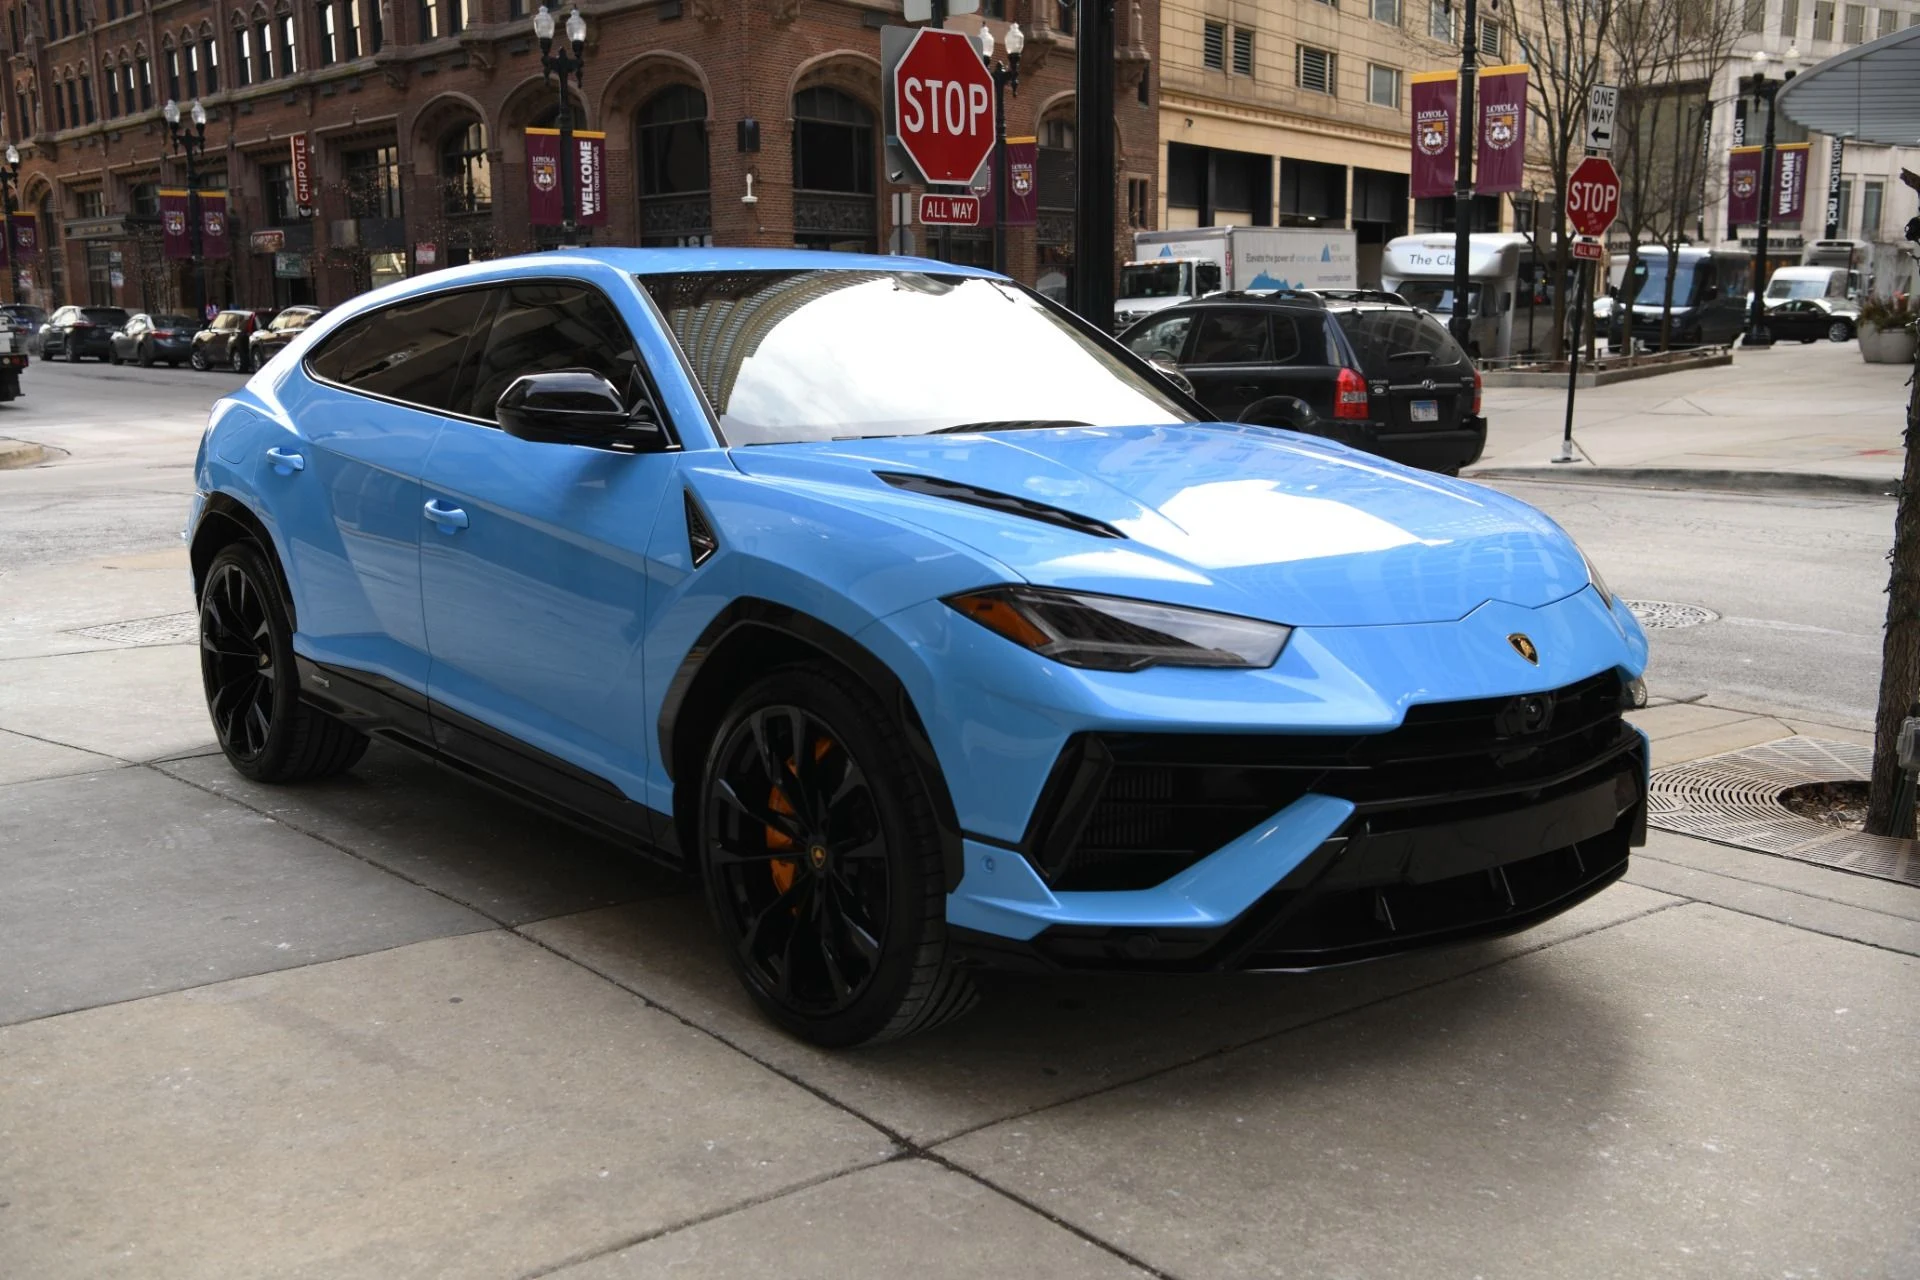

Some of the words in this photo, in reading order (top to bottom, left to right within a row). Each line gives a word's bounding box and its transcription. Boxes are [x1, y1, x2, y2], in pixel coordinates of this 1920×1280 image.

[904, 77, 988, 136] STOP
[1593, 90, 1614, 107] ONE
[1417, 110, 1448, 119] LOYOLA
[1486, 103, 1518, 113] LOYOLA
[1591, 109, 1613, 124] WAY
[295, 138, 309, 201] CHIPOTLE
[1831, 137, 1842, 193] ORDSTROM
[580, 141, 594, 216] WELCOME
[1779, 152, 1795, 215] WELCOME
[1570, 181, 1616, 213] STOP
[926, 201, 948, 218] ALL
[952, 202, 973, 219] WAY
[1576, 244, 1587, 256] ALL
[1410, 254, 1432, 265] The
